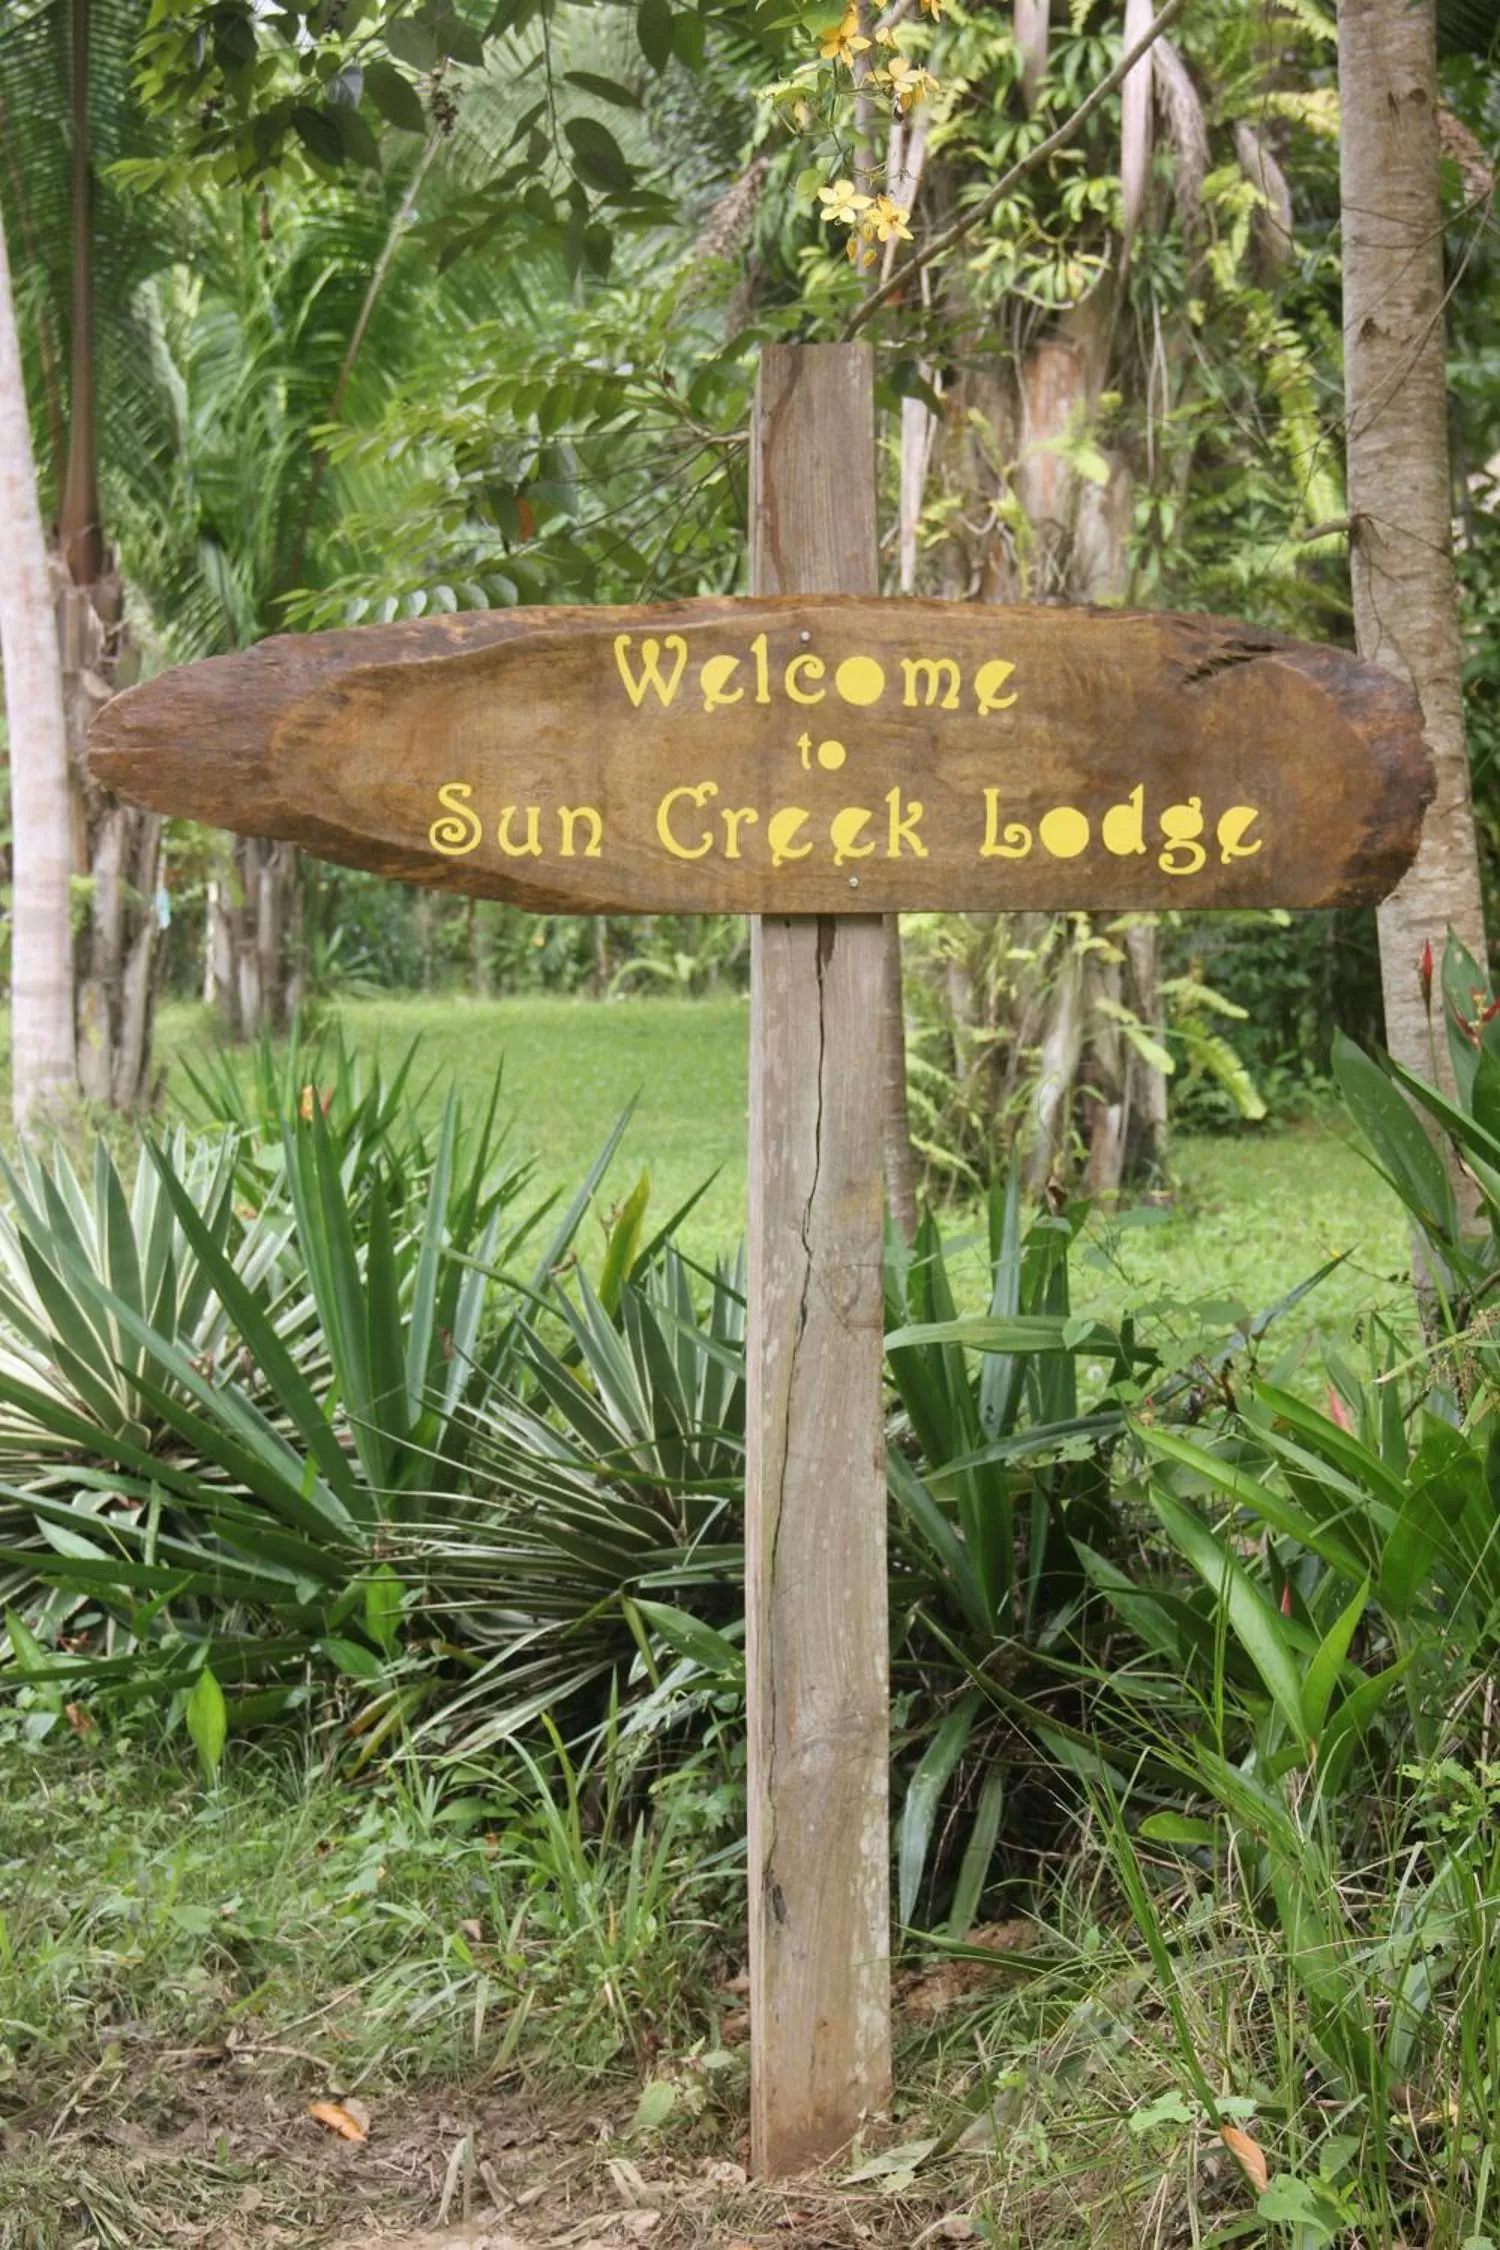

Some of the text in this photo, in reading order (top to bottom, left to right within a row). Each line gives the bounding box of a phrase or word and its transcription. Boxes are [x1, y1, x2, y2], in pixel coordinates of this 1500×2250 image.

[613, 633, 1019, 717] Welcome
[796, 731, 847, 771] to
[428, 779, 1263, 875] Sun Creek Lodge
